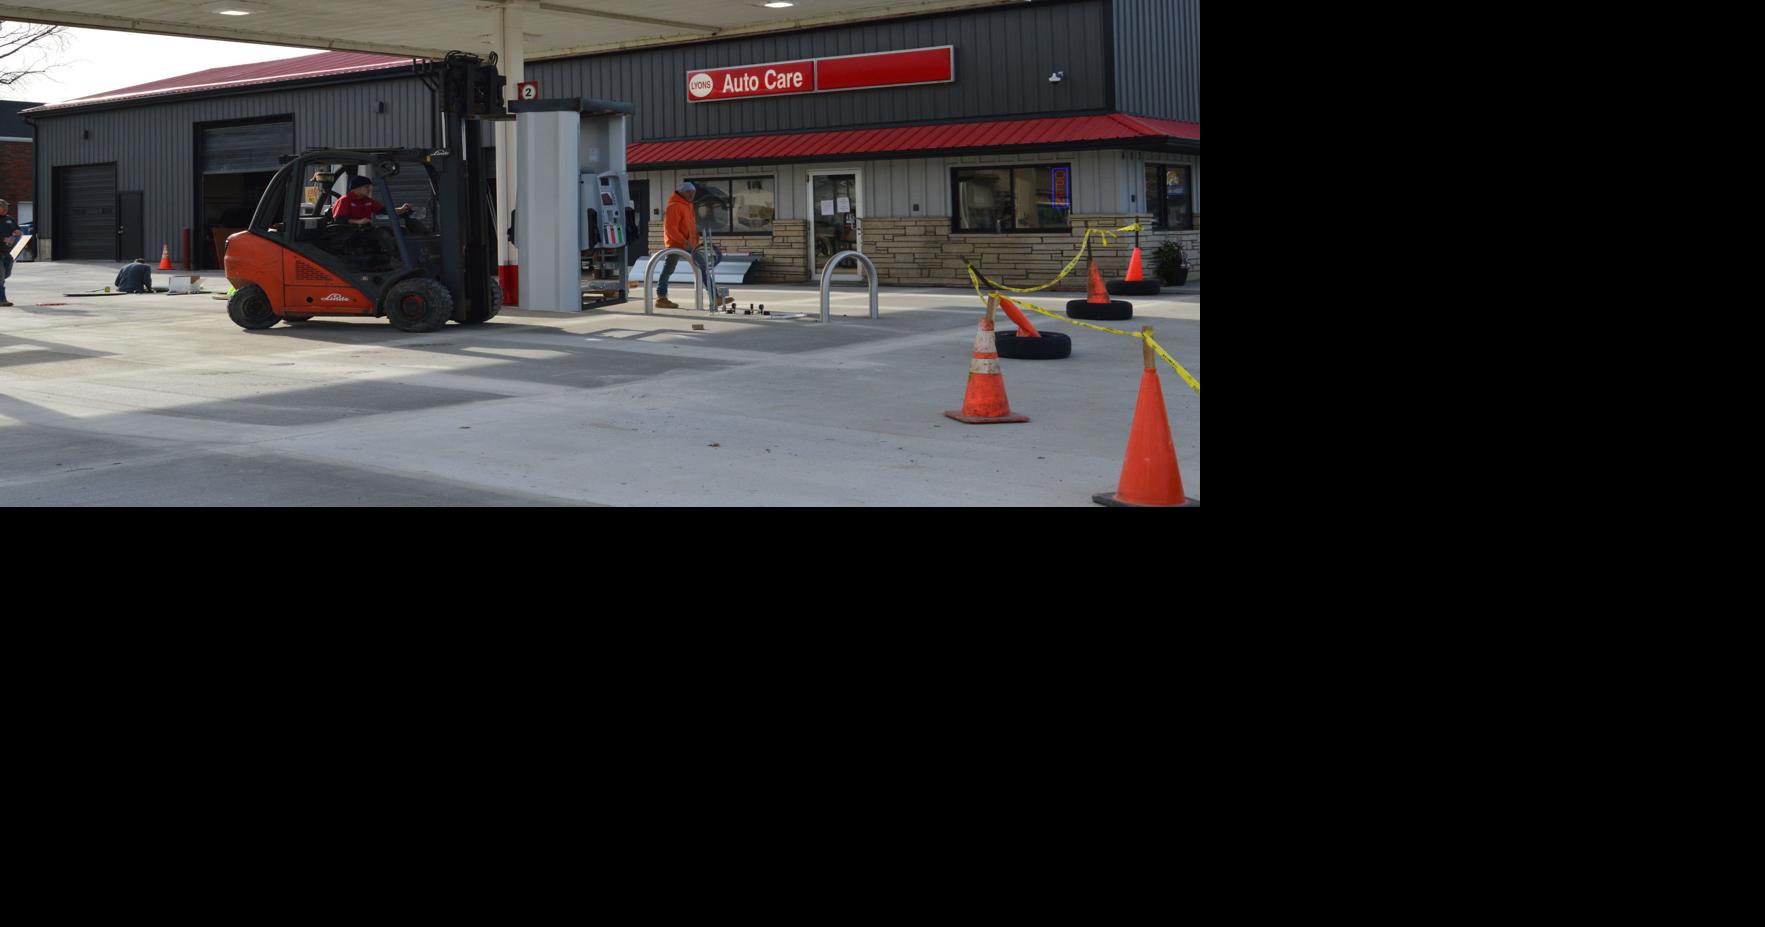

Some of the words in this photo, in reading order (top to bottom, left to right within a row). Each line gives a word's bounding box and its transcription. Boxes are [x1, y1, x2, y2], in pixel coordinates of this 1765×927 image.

[691, 80, 711, 90] LYONS
[722, 72, 759, 93] Auto
[764, 69, 803, 90] Care
[525, 87, 532, 97] 2
